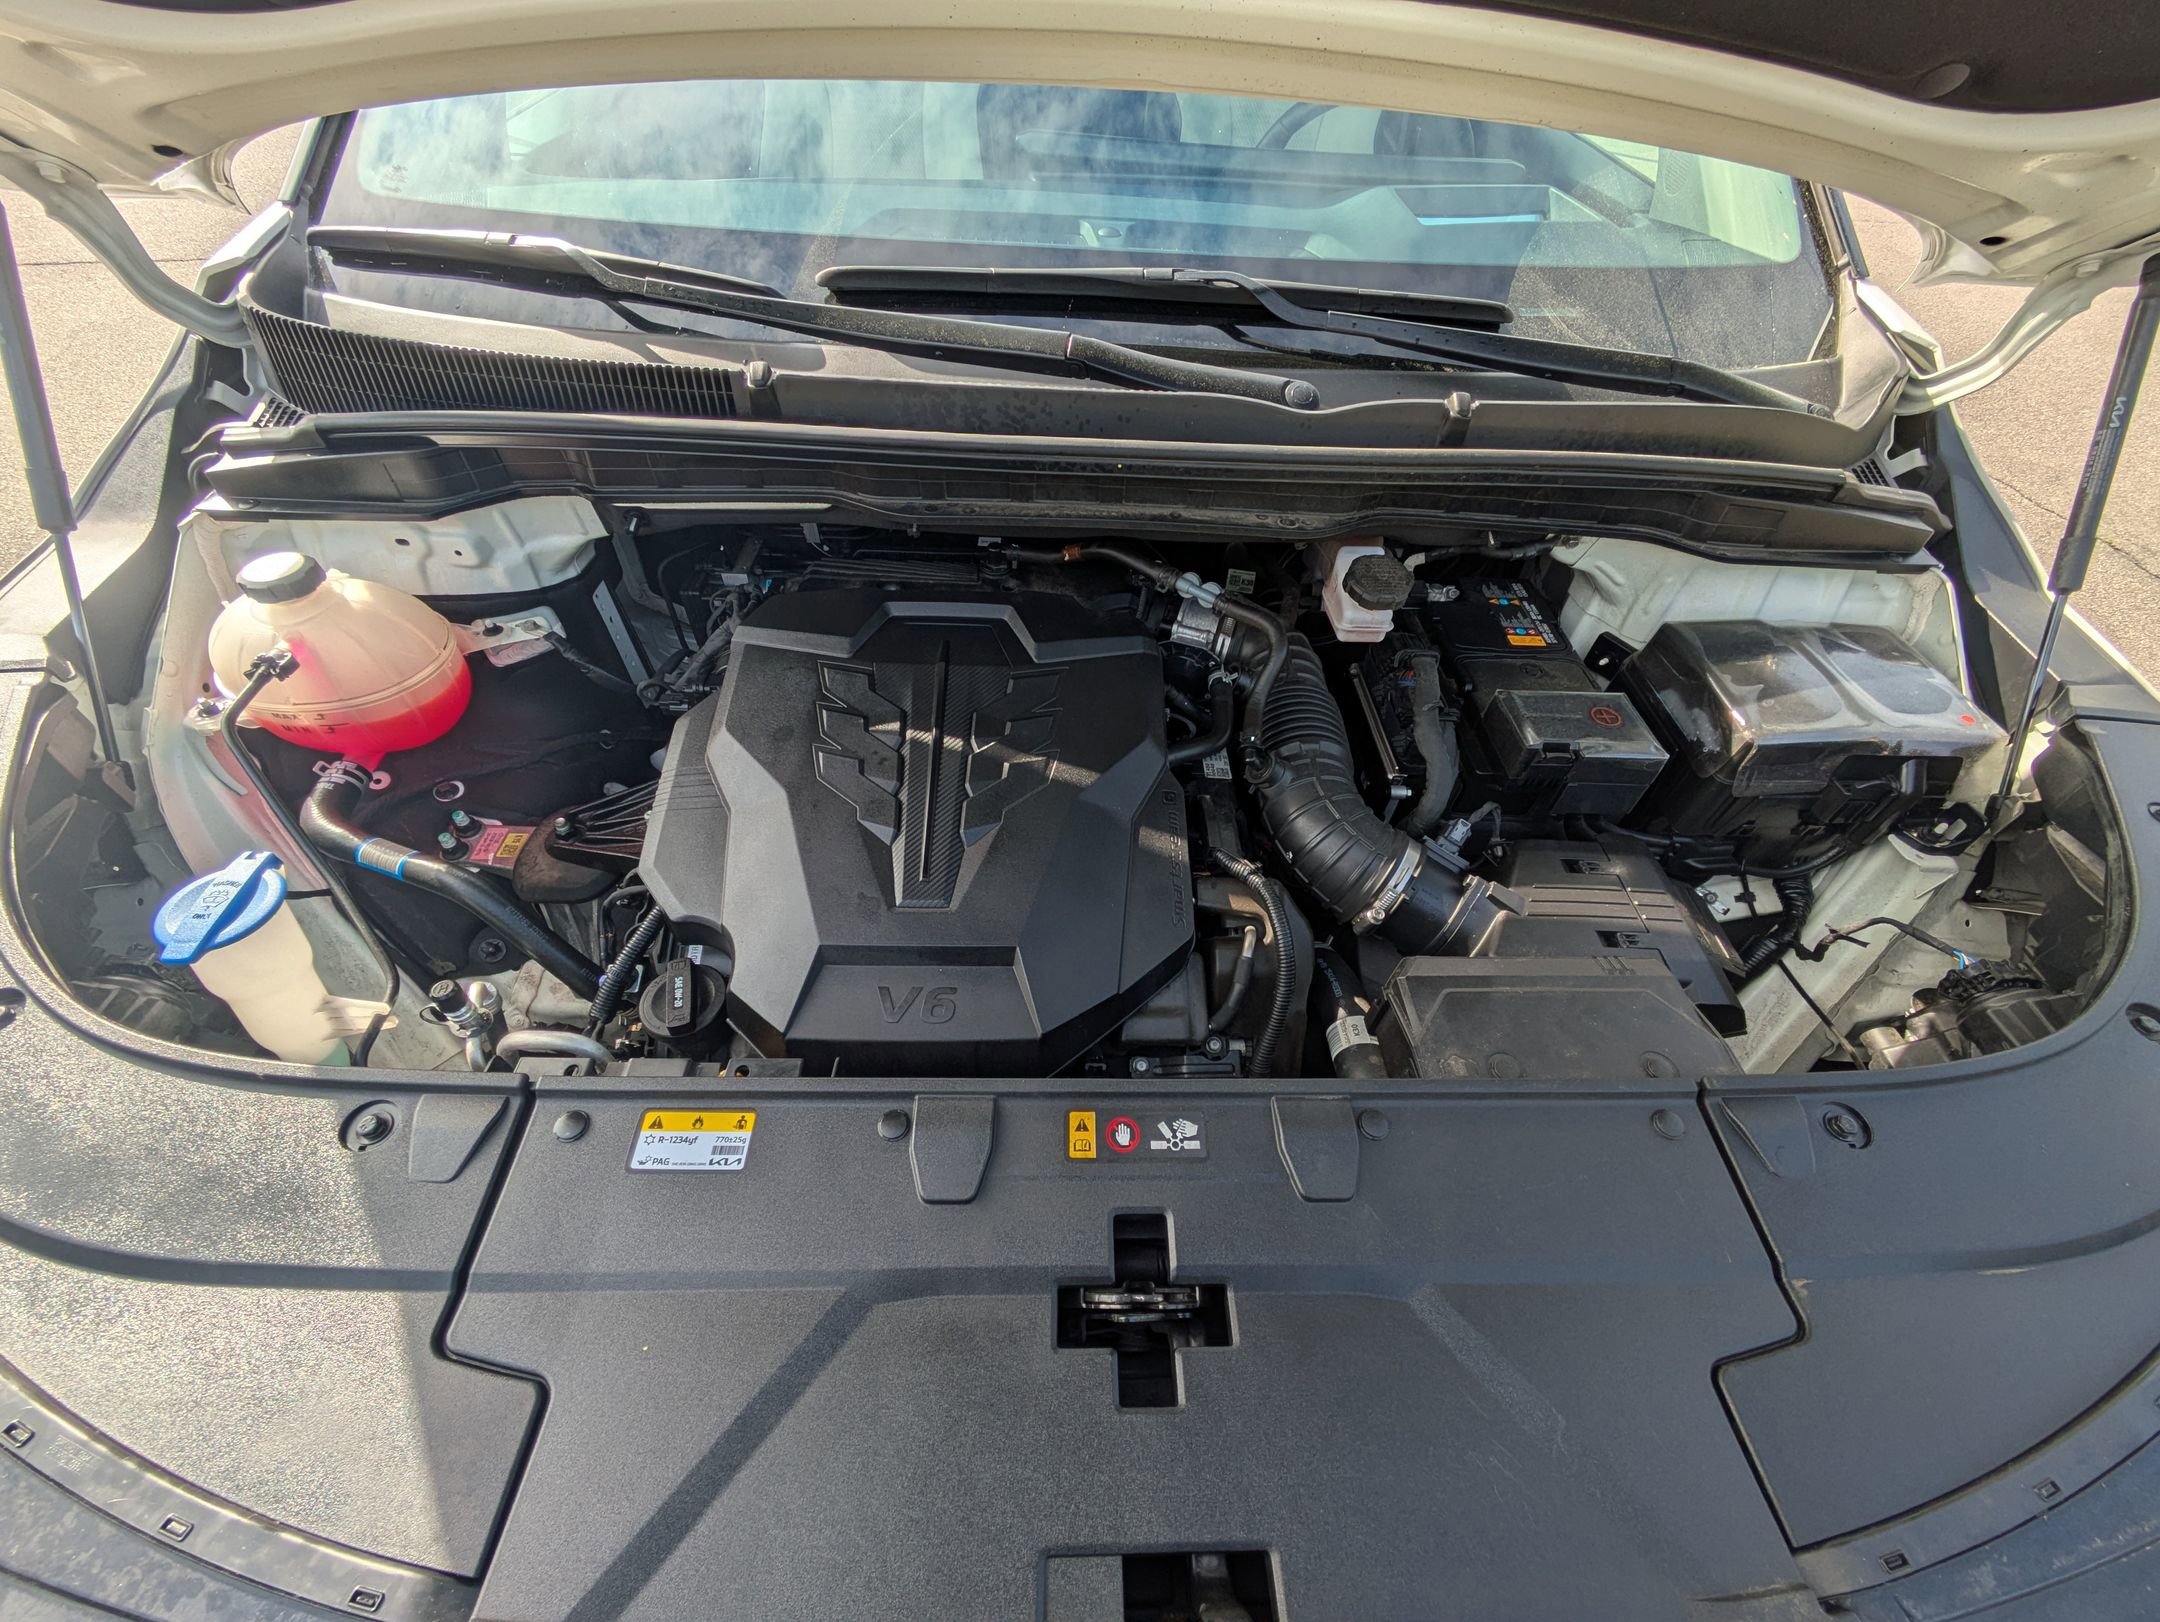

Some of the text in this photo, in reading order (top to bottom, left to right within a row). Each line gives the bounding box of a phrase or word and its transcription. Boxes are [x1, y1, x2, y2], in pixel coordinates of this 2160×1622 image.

[674, 976, 684, 989] SAE
[877, 986, 958, 1025] V6
[657, 1135, 747, 1145] R-1234yf 770±25g
[652, 1157, 670, 1166] PAG
